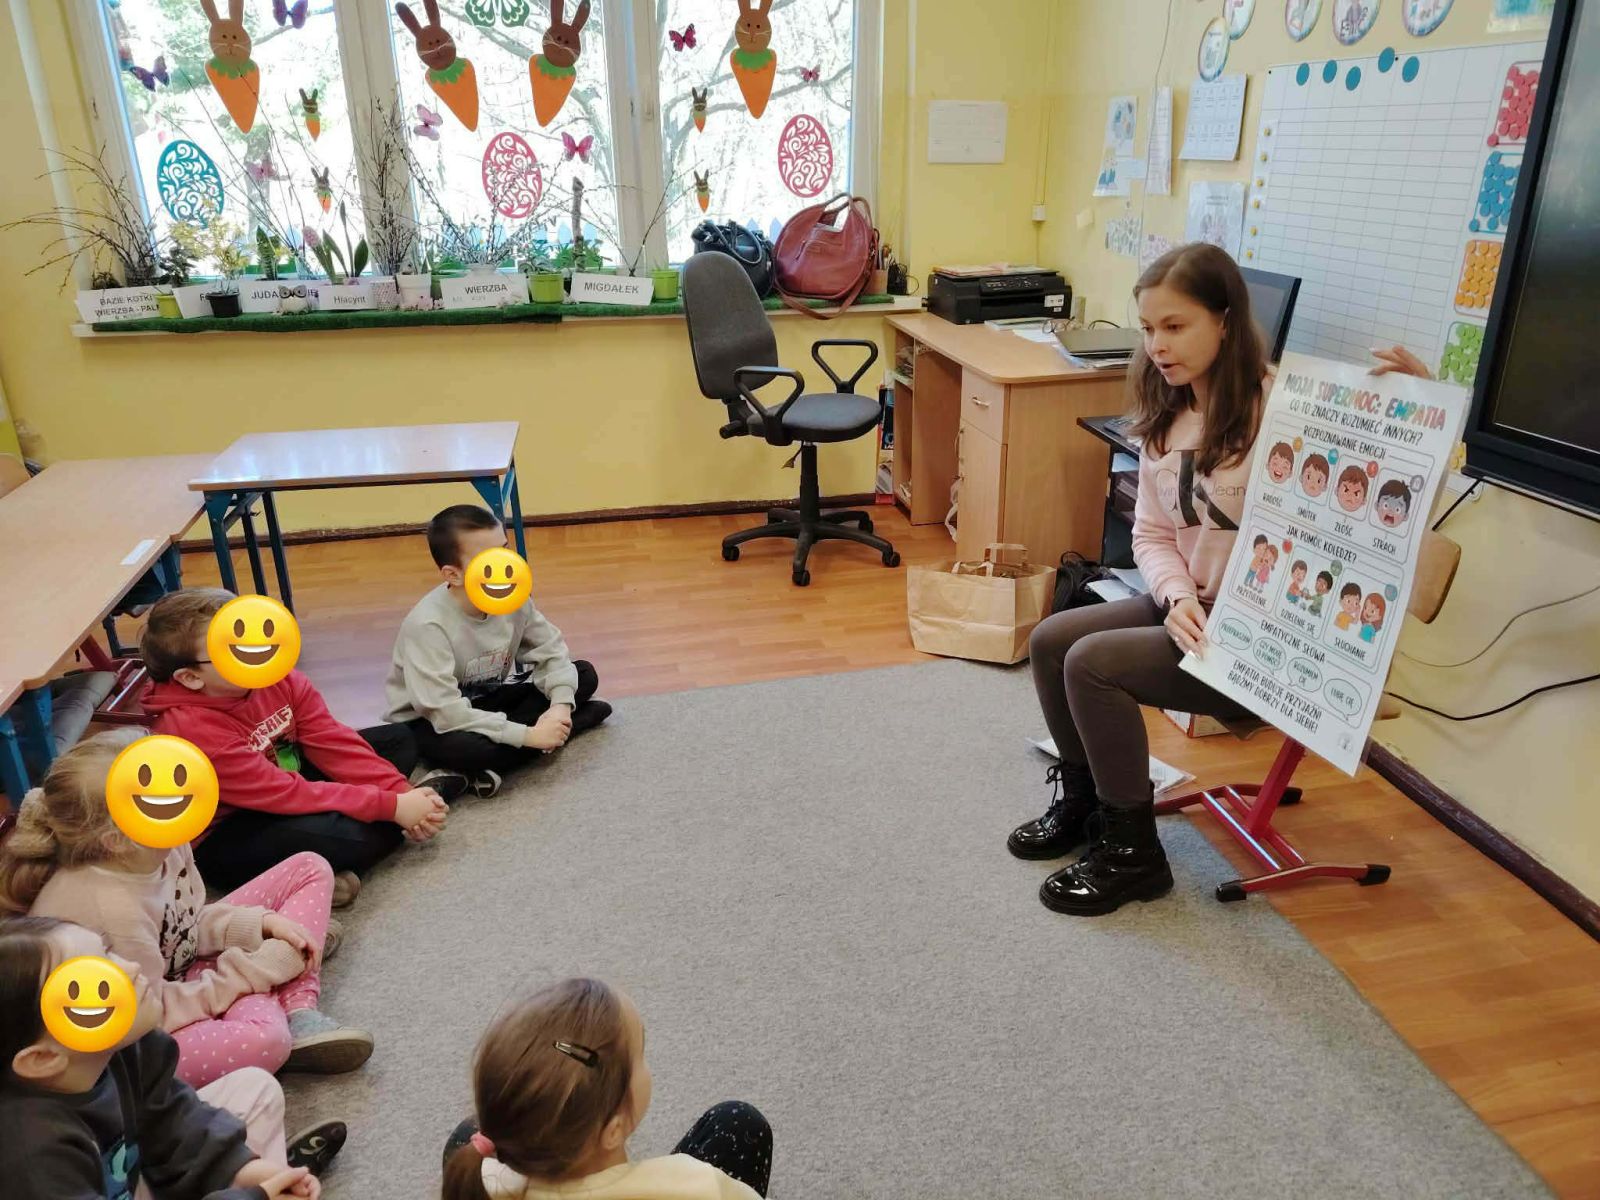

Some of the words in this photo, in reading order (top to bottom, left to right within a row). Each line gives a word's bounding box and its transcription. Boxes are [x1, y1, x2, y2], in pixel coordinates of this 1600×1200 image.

[464, 283, 508, 295] WIERZBA
[582, 281, 640, 294] MIGDAŁEK
[100, 296, 126, 306] BAZIE
[333, 295, 366, 305] Hiacynt
[95, 306, 135, 318] WIERZBA
[1283, 373, 1315, 398] MOJA
[1315, 380, 1382, 414] SUPERMOC:
[1385, 397, 1446, 431] EMPATIA
[1289, 398, 1300, 412] CO
[1301, 401, 1311, 415] TO
[1311, 404, 1340, 423] ZNACZY
[1340, 412, 1382, 434] ROZUMIEĆ
[1303, 425, 1358, 451] ROZPOZNAWANIE
[1359, 441, 1387, 460] EMOCJI
[1286, 524, 1298, 538] JAK
[1323, 540, 1357, 564] KOLEDZE?
[1372, 537, 1397, 555] STRACH
[1260, 619, 1301, 651] EMPATYCZNE
[1301, 642, 1326, 663] SŁOWA
[1334, 637, 1366, 661] SŁUCHANIE
[1232, 659, 1260, 681] EMPATIA
[1280, 703, 1293, 718] DLA
